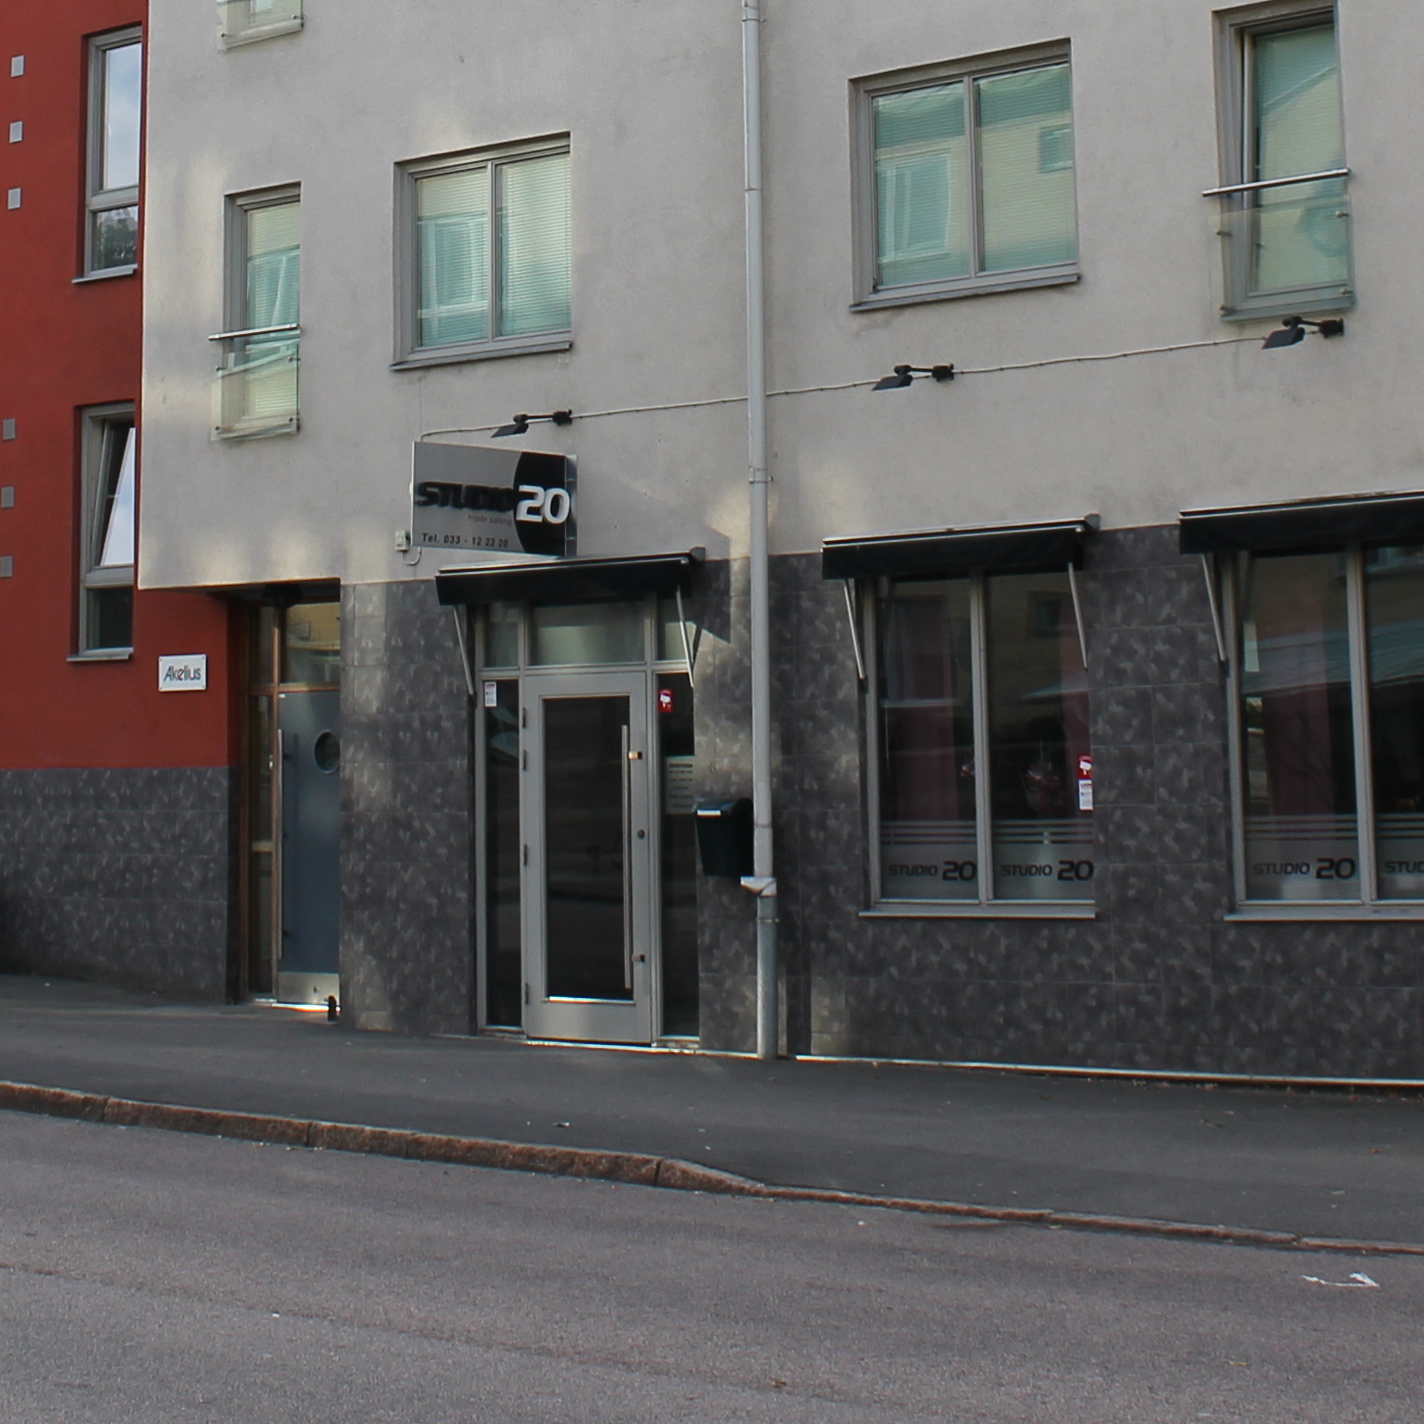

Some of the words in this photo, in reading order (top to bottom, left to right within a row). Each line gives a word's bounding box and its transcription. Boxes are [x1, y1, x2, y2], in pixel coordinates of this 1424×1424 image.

[415, 481, 516, 513] STUDIO
[516, 484, 570, 524] 20
[422, 532, 439, 543] Tel.
[163, 665, 202, 682] Akelius
[888, 864, 938, 876] STUDIO
[942, 860, 977, 882] 20
[1000, 864, 1053, 877] STUDIO
[1057, 859, 1095, 882] 20
[1253, 862, 1311, 875] STUDIO
[1315, 857, 1356, 880] 20
